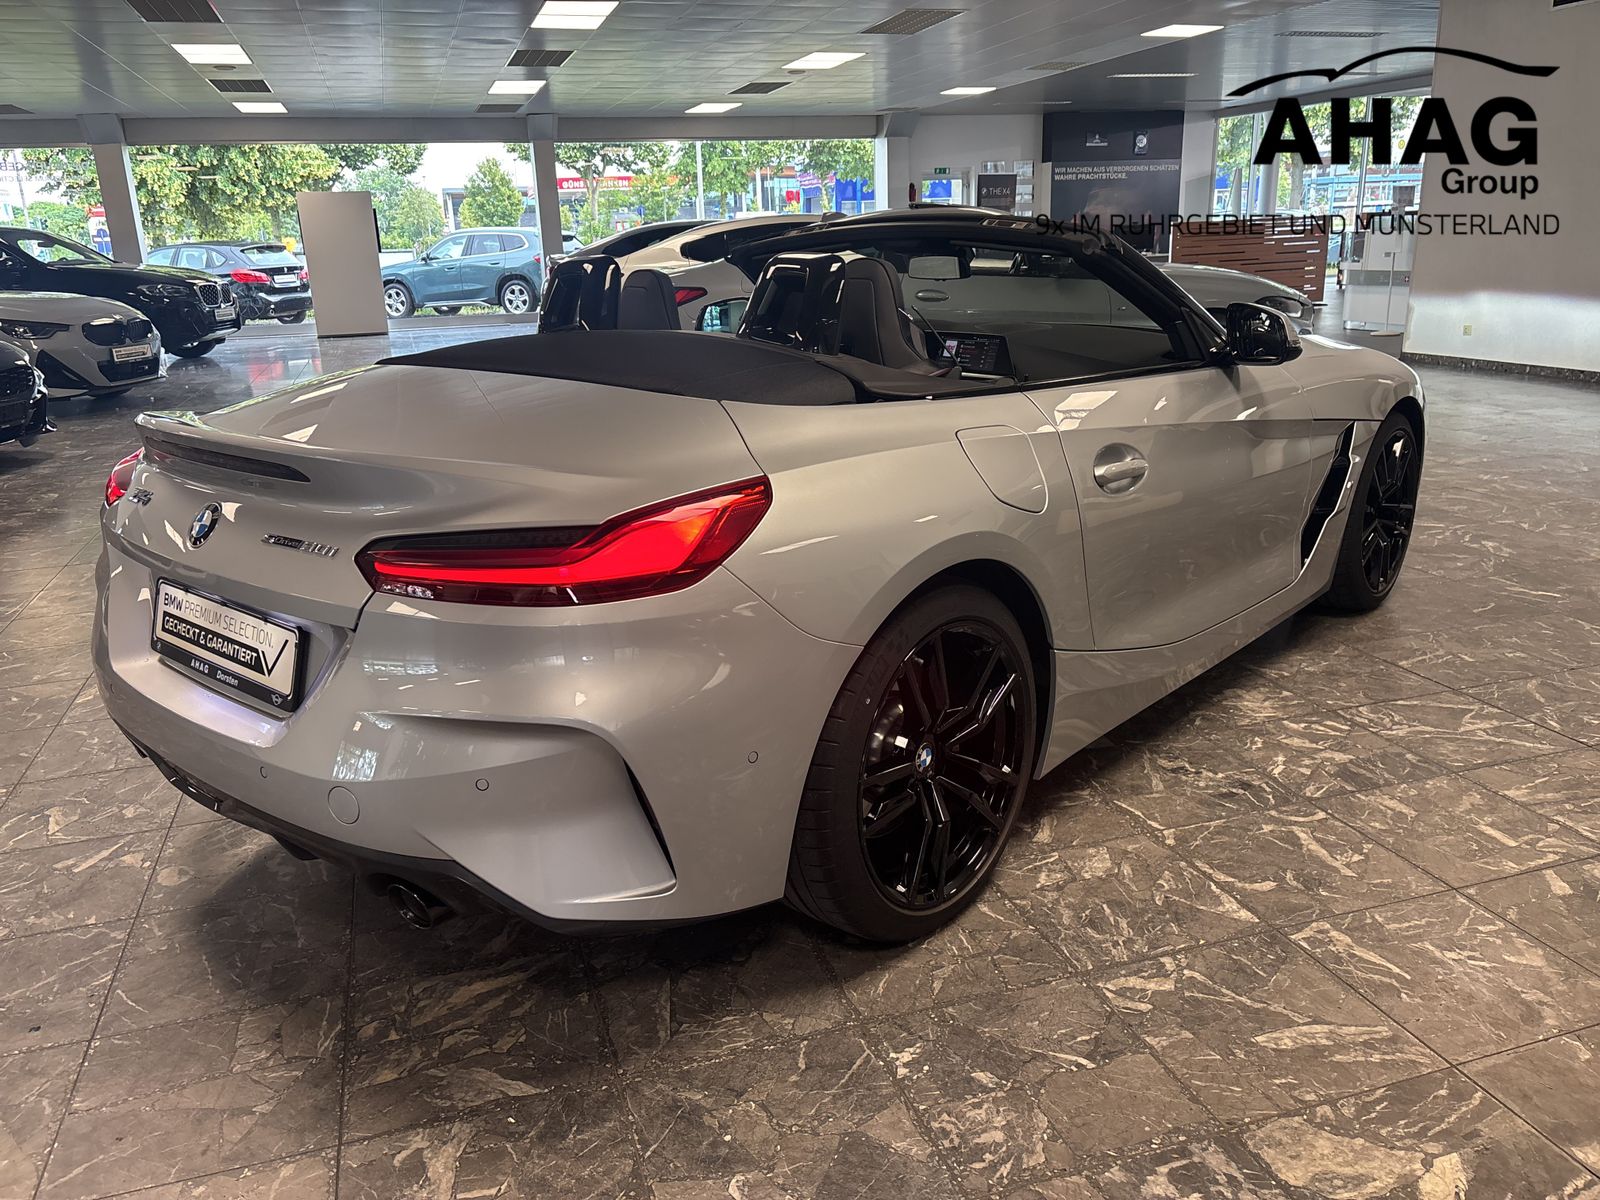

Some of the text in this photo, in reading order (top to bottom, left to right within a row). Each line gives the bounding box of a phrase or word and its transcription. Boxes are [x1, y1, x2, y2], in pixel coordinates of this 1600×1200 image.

[163, 592, 274, 649] BMW PREMIUM SELECTION.
[164, 616, 258, 666] GECHECKT & GARANTIERT
[190, 658, 239, 687] AHAG Dorsten
